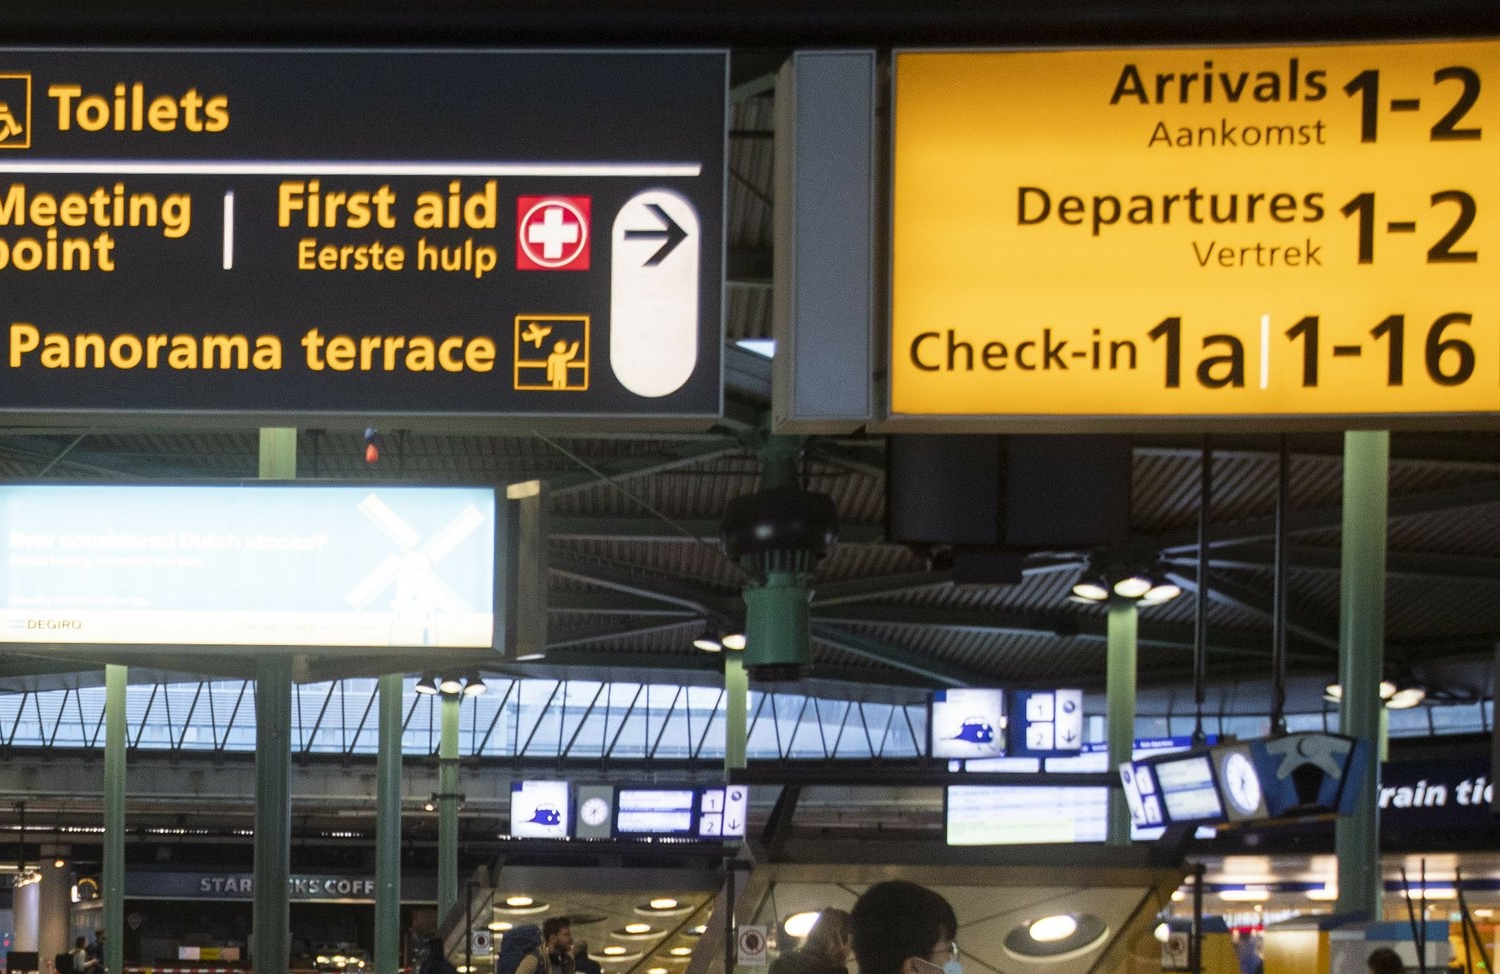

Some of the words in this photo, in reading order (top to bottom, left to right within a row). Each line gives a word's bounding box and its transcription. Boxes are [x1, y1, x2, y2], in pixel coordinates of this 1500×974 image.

[48, 83, 230, 132] Toilets
[1110, 57, 1327, 105] Arrivals
[1343, 65, 1483, 143] 1-2
[1148, 119, 1326, 148] Aankomst
[278, 180, 396, 228] First
[414, 180, 497, 228] aid
[1017, 186, 1325, 236] Departures
[1340, 189, 1479, 265] 1-2
[298, 239, 405, 270] Eerste
[417, 238, 497, 278] hulp
[1191, 238, 1322, 267] Vertrek
[9, 323, 282, 371] Panorama
[302, 328, 496, 372] terrace
[909, 328, 1138, 372] Check-in
[1148, 316, 1245, 390] 1a
[1285, 312, 1476, 388] 1-16
[10, 532, 56, 549] Ever
[60, 531, 175, 549] considered
[179, 531, 240, 549] Dutch
[244, 533, 328, 550] stocks?
[27, 619, 82, 630] DEGIRO
[1035, 732, 1044, 745] 2
[1377, 780, 1448, 808] rain
[706, 821, 715, 832] 2
